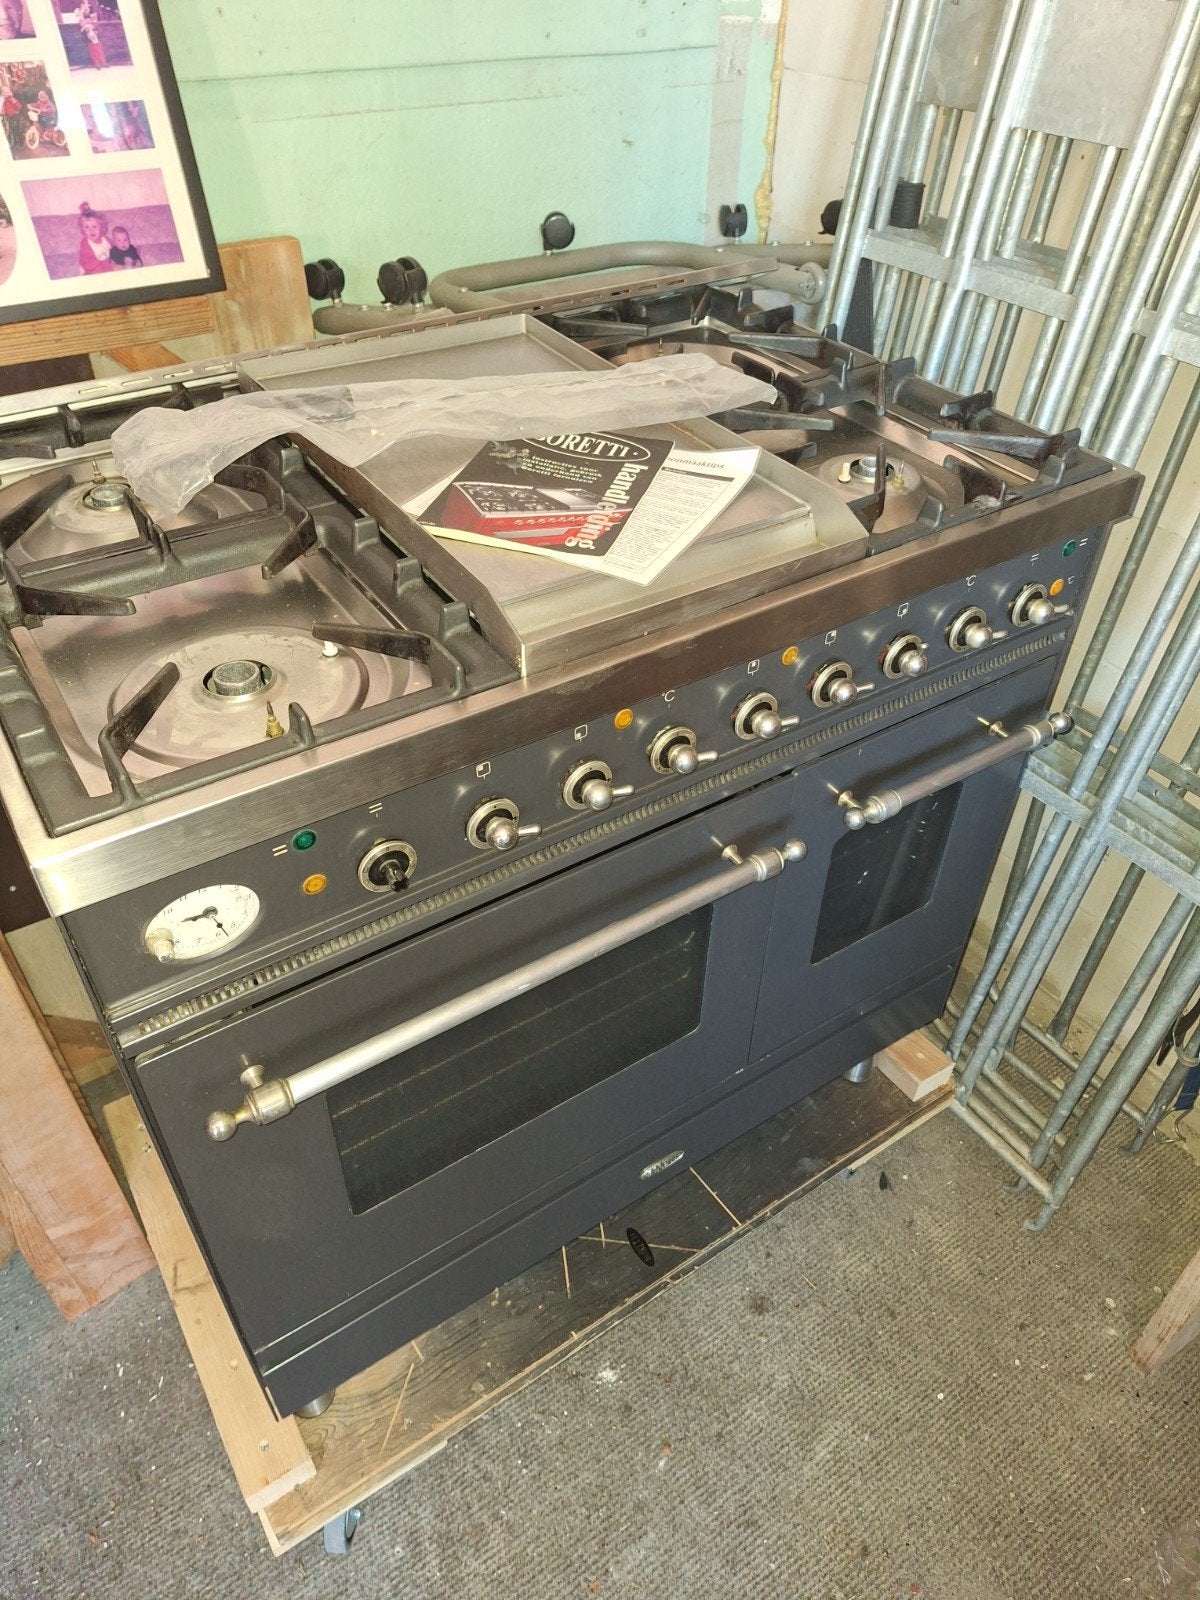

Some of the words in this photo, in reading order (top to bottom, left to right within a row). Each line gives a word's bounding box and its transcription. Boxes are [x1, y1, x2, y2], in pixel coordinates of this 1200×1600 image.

[535, 434, 630, 457] ORETTI
[565, 462, 649, 550] handleiding
[661, 689, 676, 702] °C
